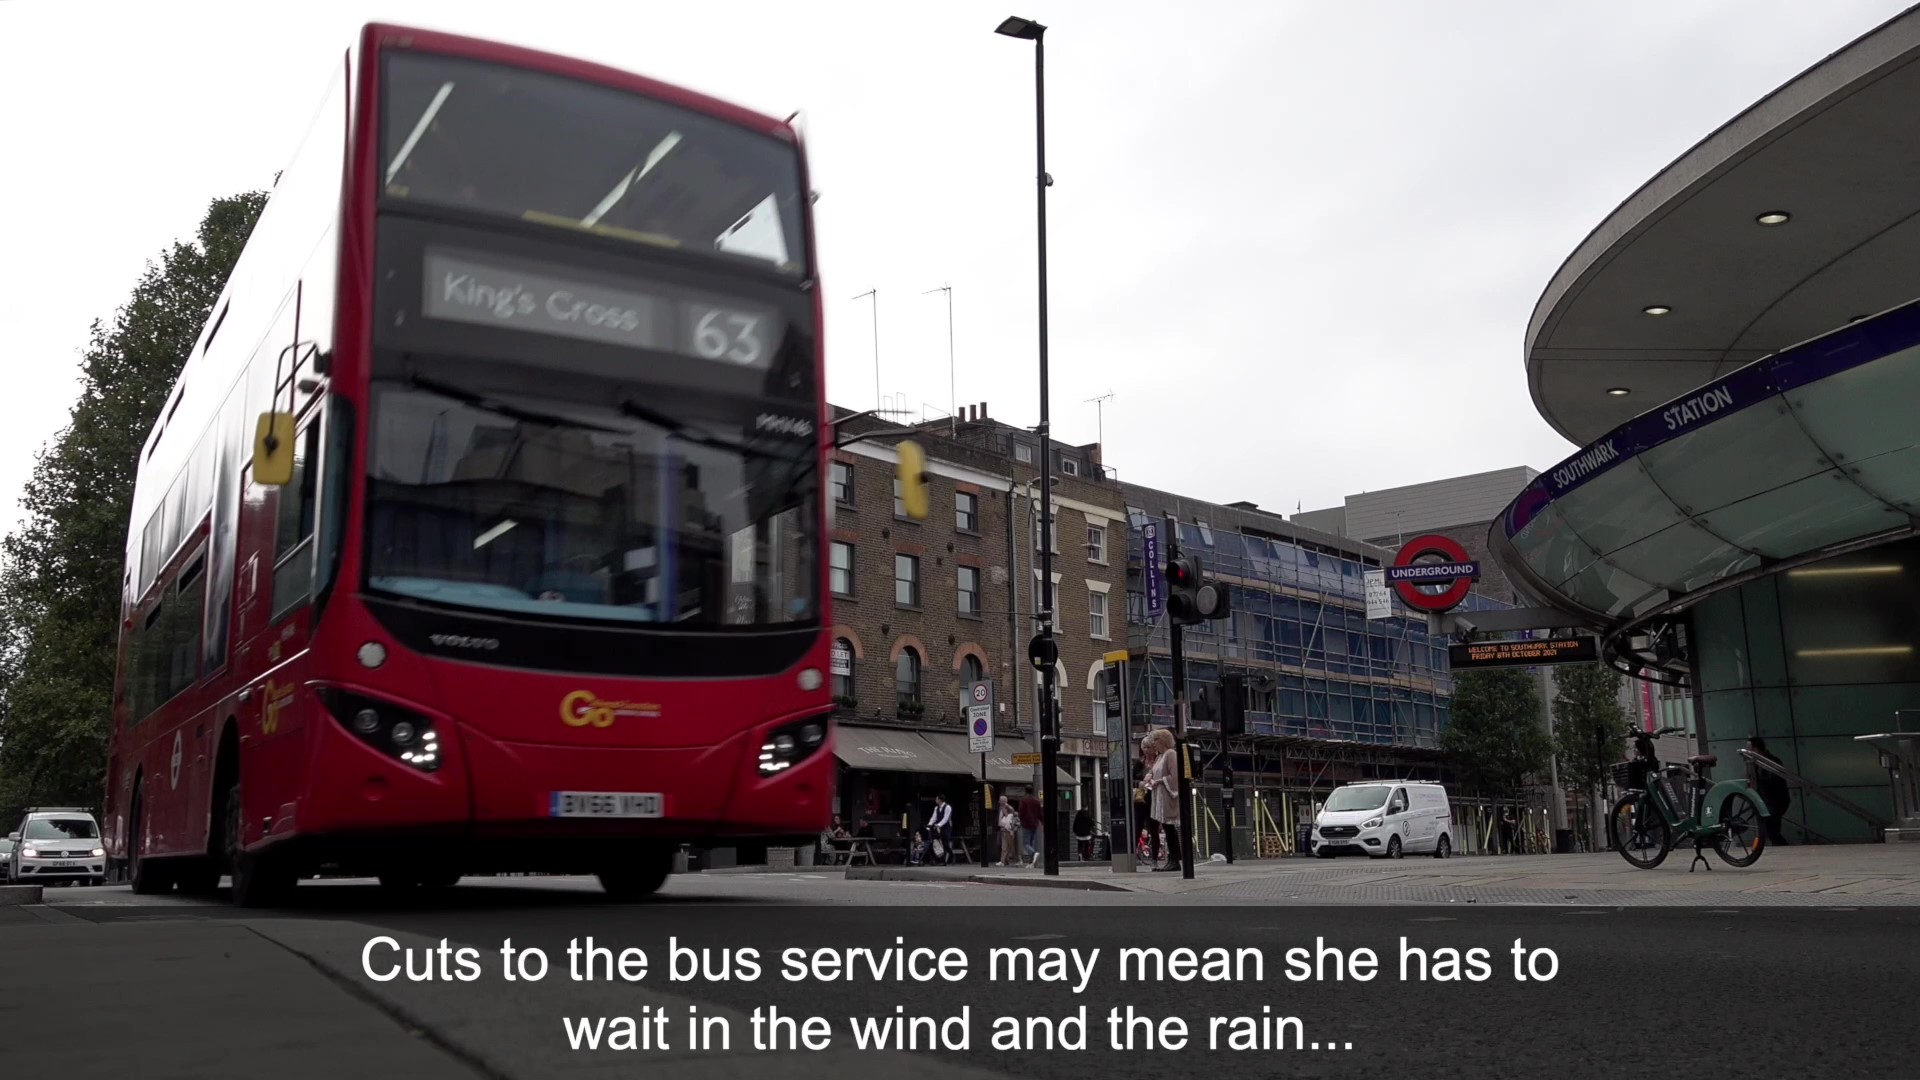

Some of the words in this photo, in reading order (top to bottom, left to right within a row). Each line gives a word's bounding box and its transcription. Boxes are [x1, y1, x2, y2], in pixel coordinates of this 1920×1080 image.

[443, 271, 535, 319] King's
[546, 290, 638, 332] Cross
[692, 309, 761, 365] 63
[1553, 438, 1620, 489] SOUTHWARK
[1664, 386, 1733, 431] STATION
[1148, 541, 1157, 608] COLLINS
[1391, 564, 1473, 578] UNDERGROUND
[429, 633, 500, 650] VOLVO
[1468, 645, 1498, 653] WELCOME
[1511, 643, 1547, 651] SOUTHWARK
[1550, 641, 1579, 649] STATION
[1471, 653, 1495, 661] FRIDAY
[1512, 650, 1541, 658] OCTOBER
[1543, 649, 1557, 657] 2021
[975, 689, 985, 697] 20
[559, 690, 616, 728] Go
[564, 795, 613, 813] BV66
